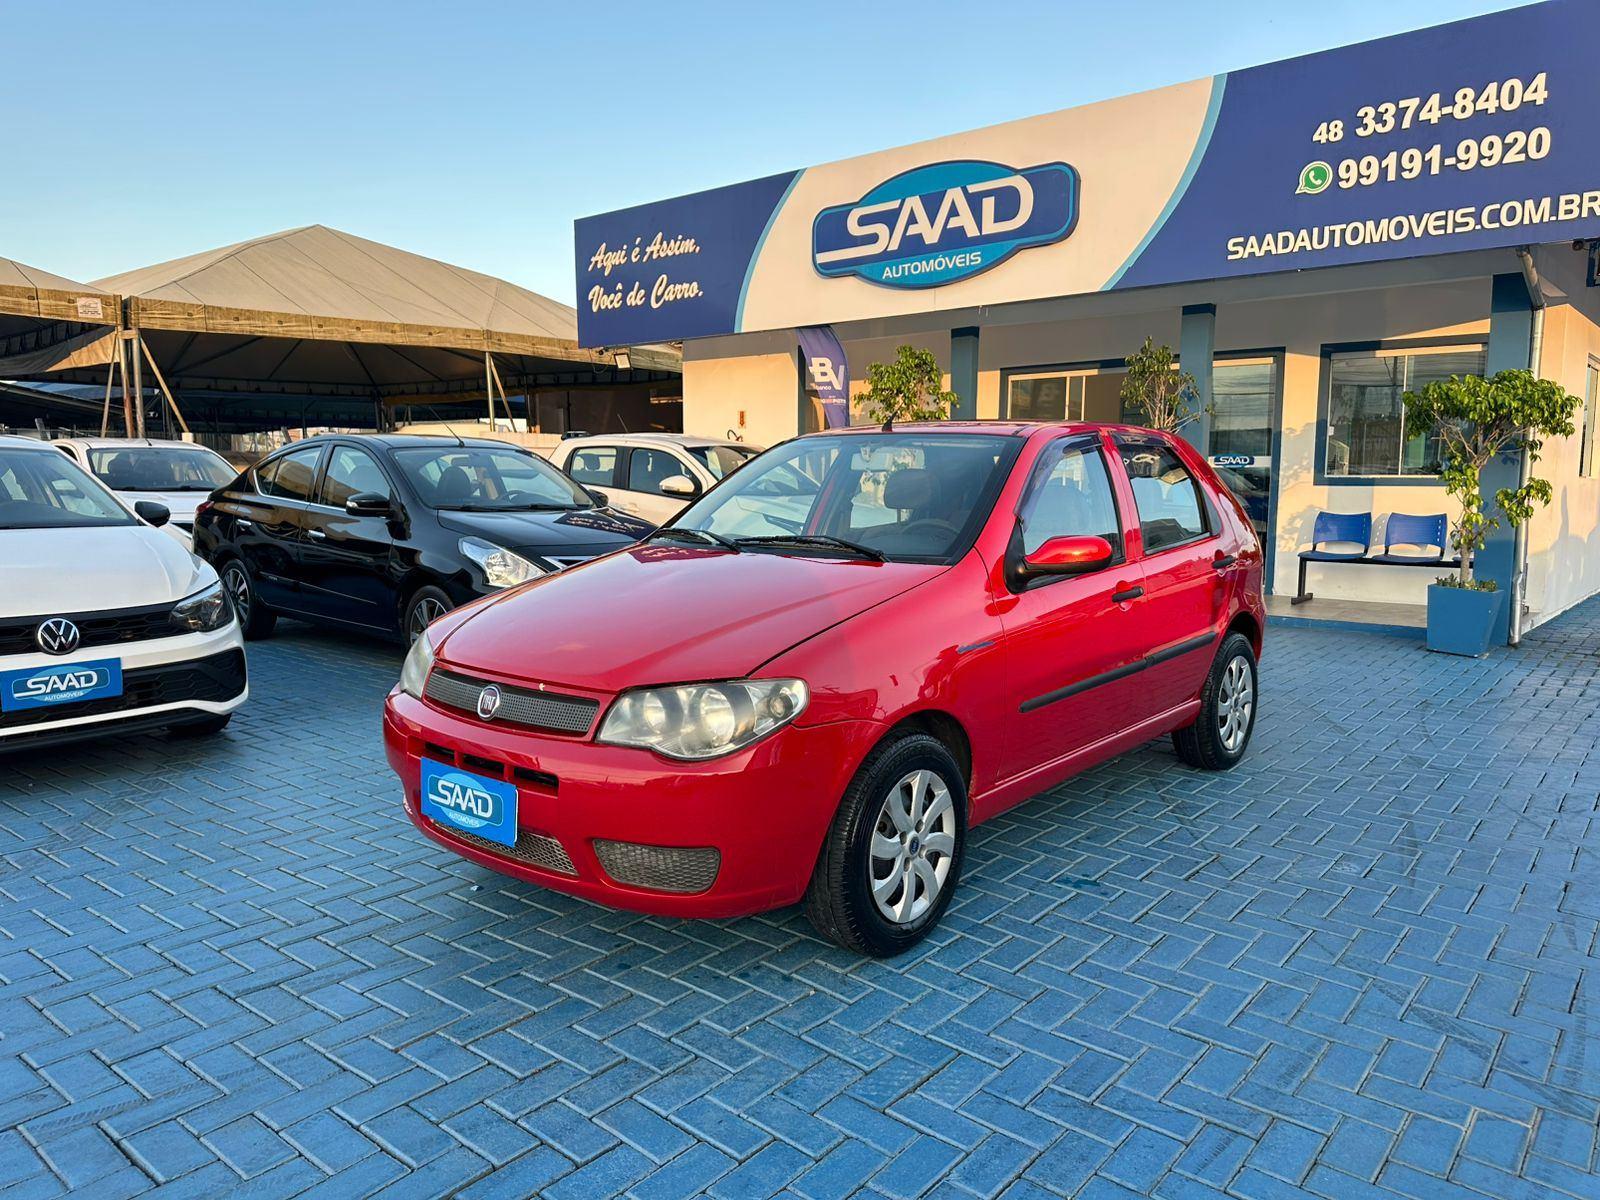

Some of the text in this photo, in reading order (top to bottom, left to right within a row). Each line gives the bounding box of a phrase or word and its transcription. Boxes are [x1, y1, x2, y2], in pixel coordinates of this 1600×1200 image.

[1312, 72, 1548, 145] 48 3374-8404
[1337, 127, 1551, 190] 99191-9920
[816, 175, 1034, 264] SAAD
[1227, 190, 1600, 260] SAADAUTOMOVEIS.COM.BR
[588, 232, 700, 277] Aqui é Assim.
[882, 252, 981, 280] AUTOMÓVEIS
[588, 274, 704, 313] Você de Carro.
[809, 357, 845, 391] BV
[1214, 456, 1250, 465] SAAD
[14, 670, 98, 698] SAAD
[429, 779, 493, 819] SAAD
